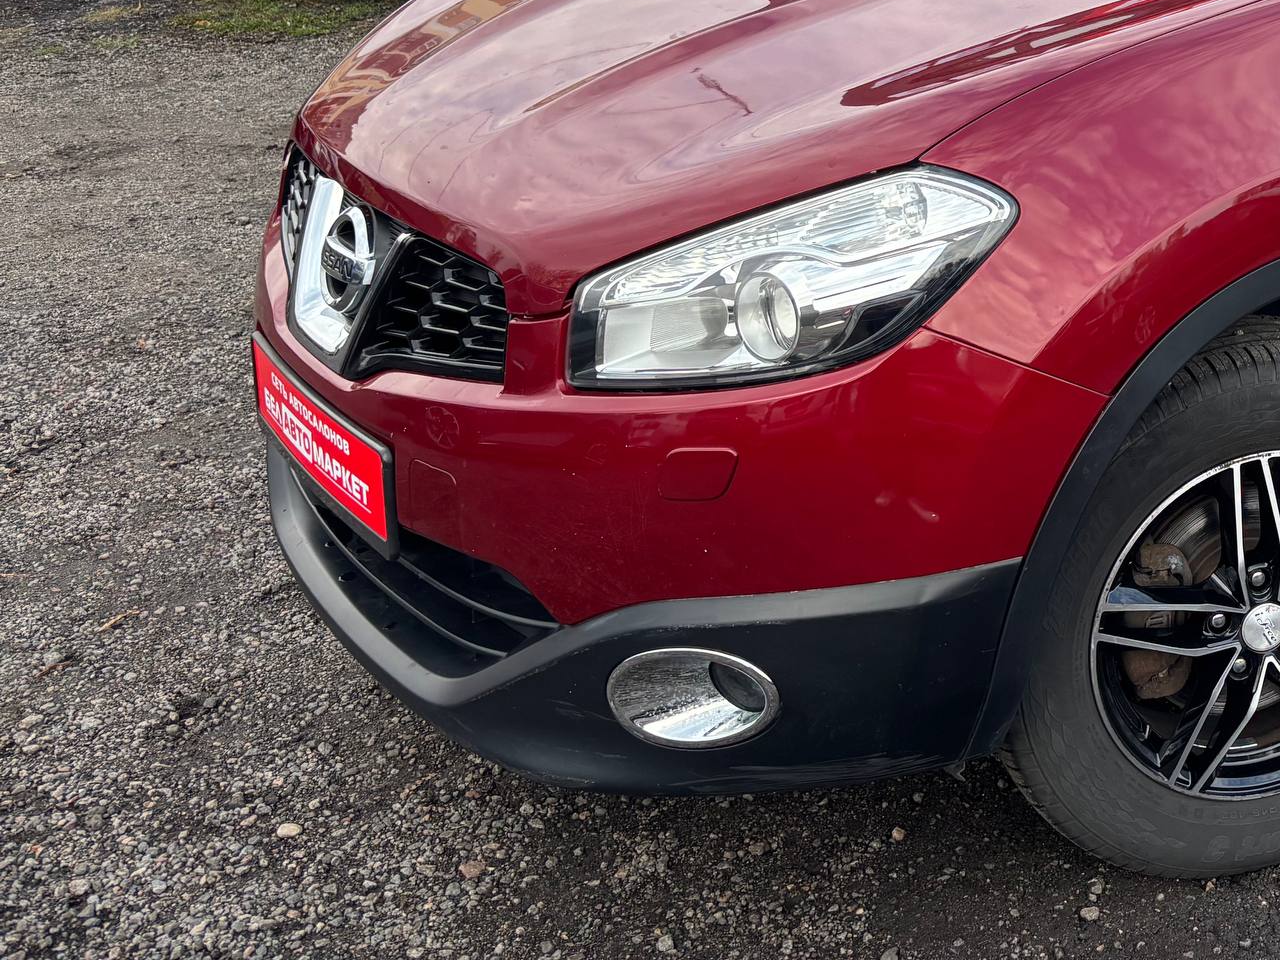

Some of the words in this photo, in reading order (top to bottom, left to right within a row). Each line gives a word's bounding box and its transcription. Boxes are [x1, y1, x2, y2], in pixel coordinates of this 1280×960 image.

[264, 387, 283, 425] БЕЛ
[283, 413, 312, 458] АВТО
[313, 446, 370, 506] МАРКЕТ
[271, 372, 289, 400] СЕТЬ
[289, 391, 350, 457] АВТОСАЛОНОВ
